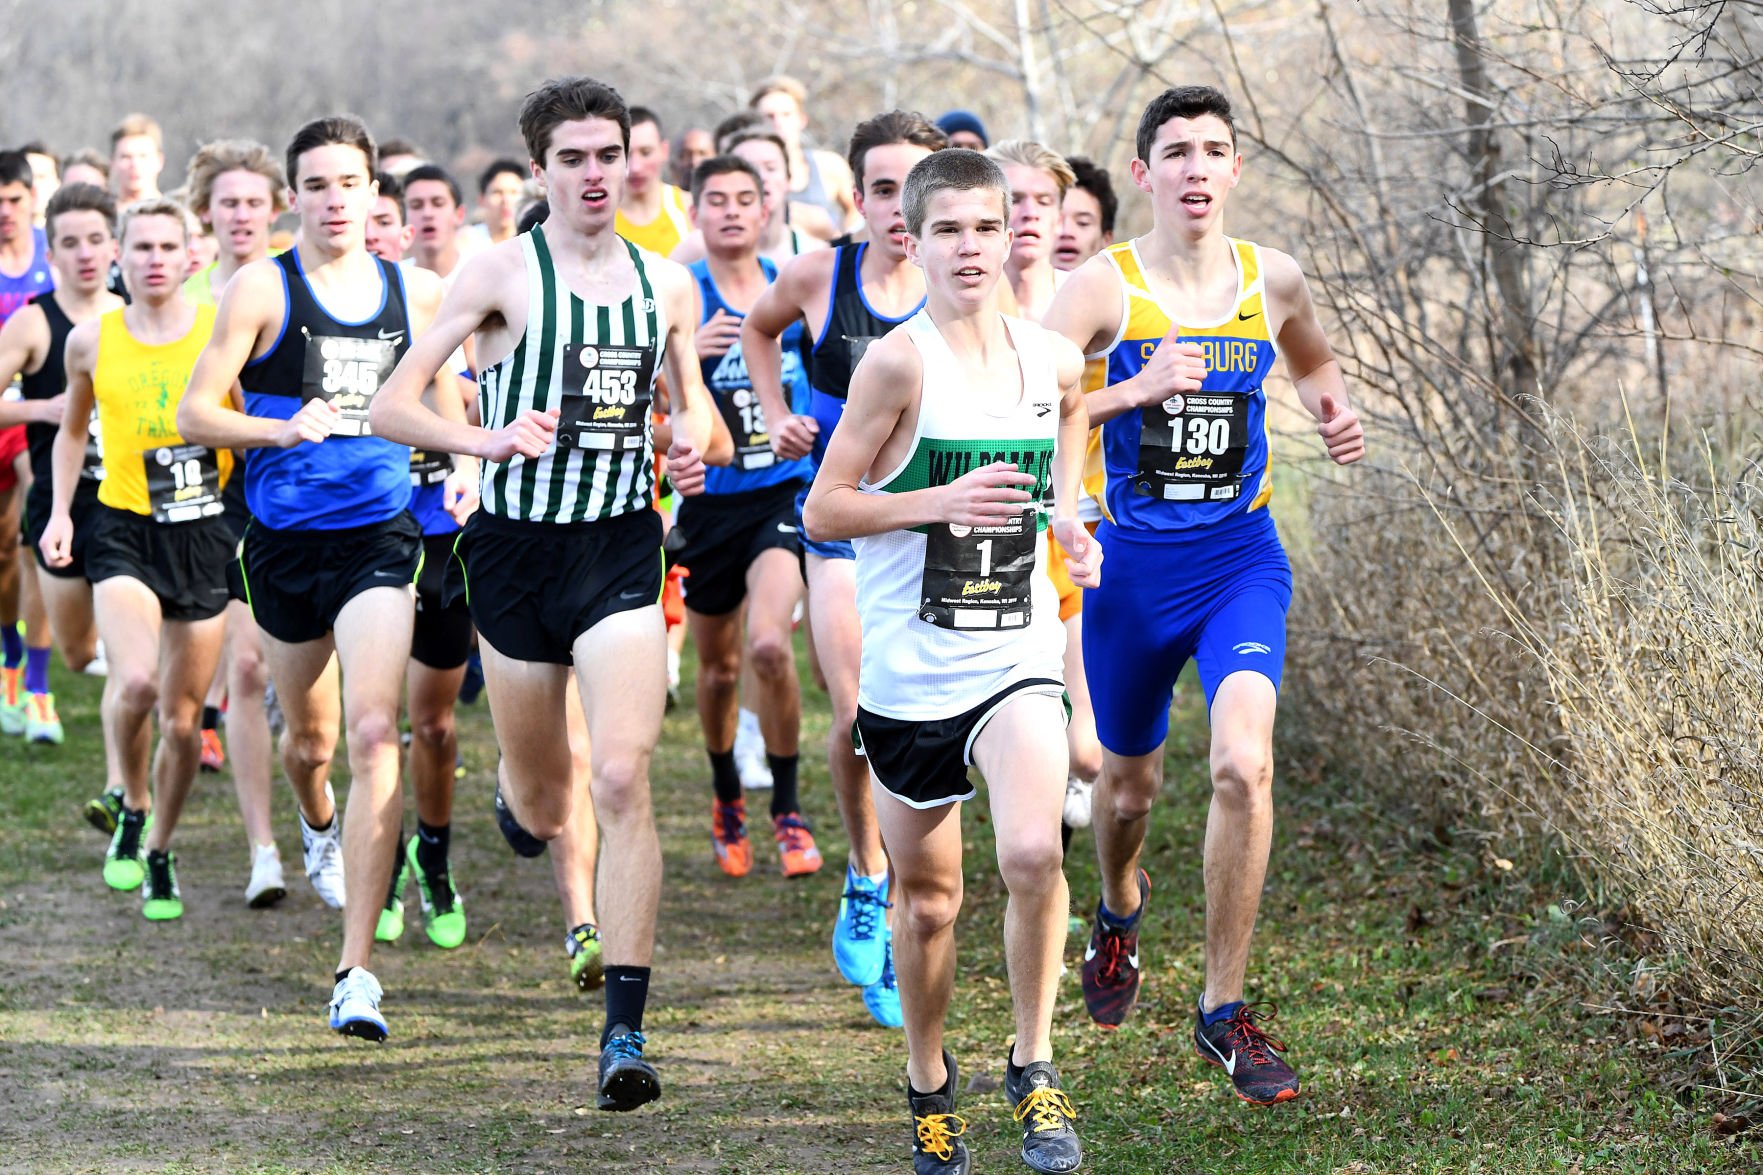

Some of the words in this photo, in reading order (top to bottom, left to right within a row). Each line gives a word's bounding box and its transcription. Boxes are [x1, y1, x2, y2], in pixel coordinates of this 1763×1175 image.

[1140, 341, 1257, 373] SBURG
[322, 359, 378, 396] 345
[582, 369, 638, 405] 453
[1186, 397, 1207, 405] CROSS
[1208, 398, 1234, 406] COUNTRY
[1186, 405, 1234, 414] CHAMPIONSHIPS
[1167, 416, 1230, 456] 130
[973, 525, 1023, 534] CHAMPIONSHIPS
[1006, 517, 1023, 525] NTRY
[976, 539, 993, 577] 1
